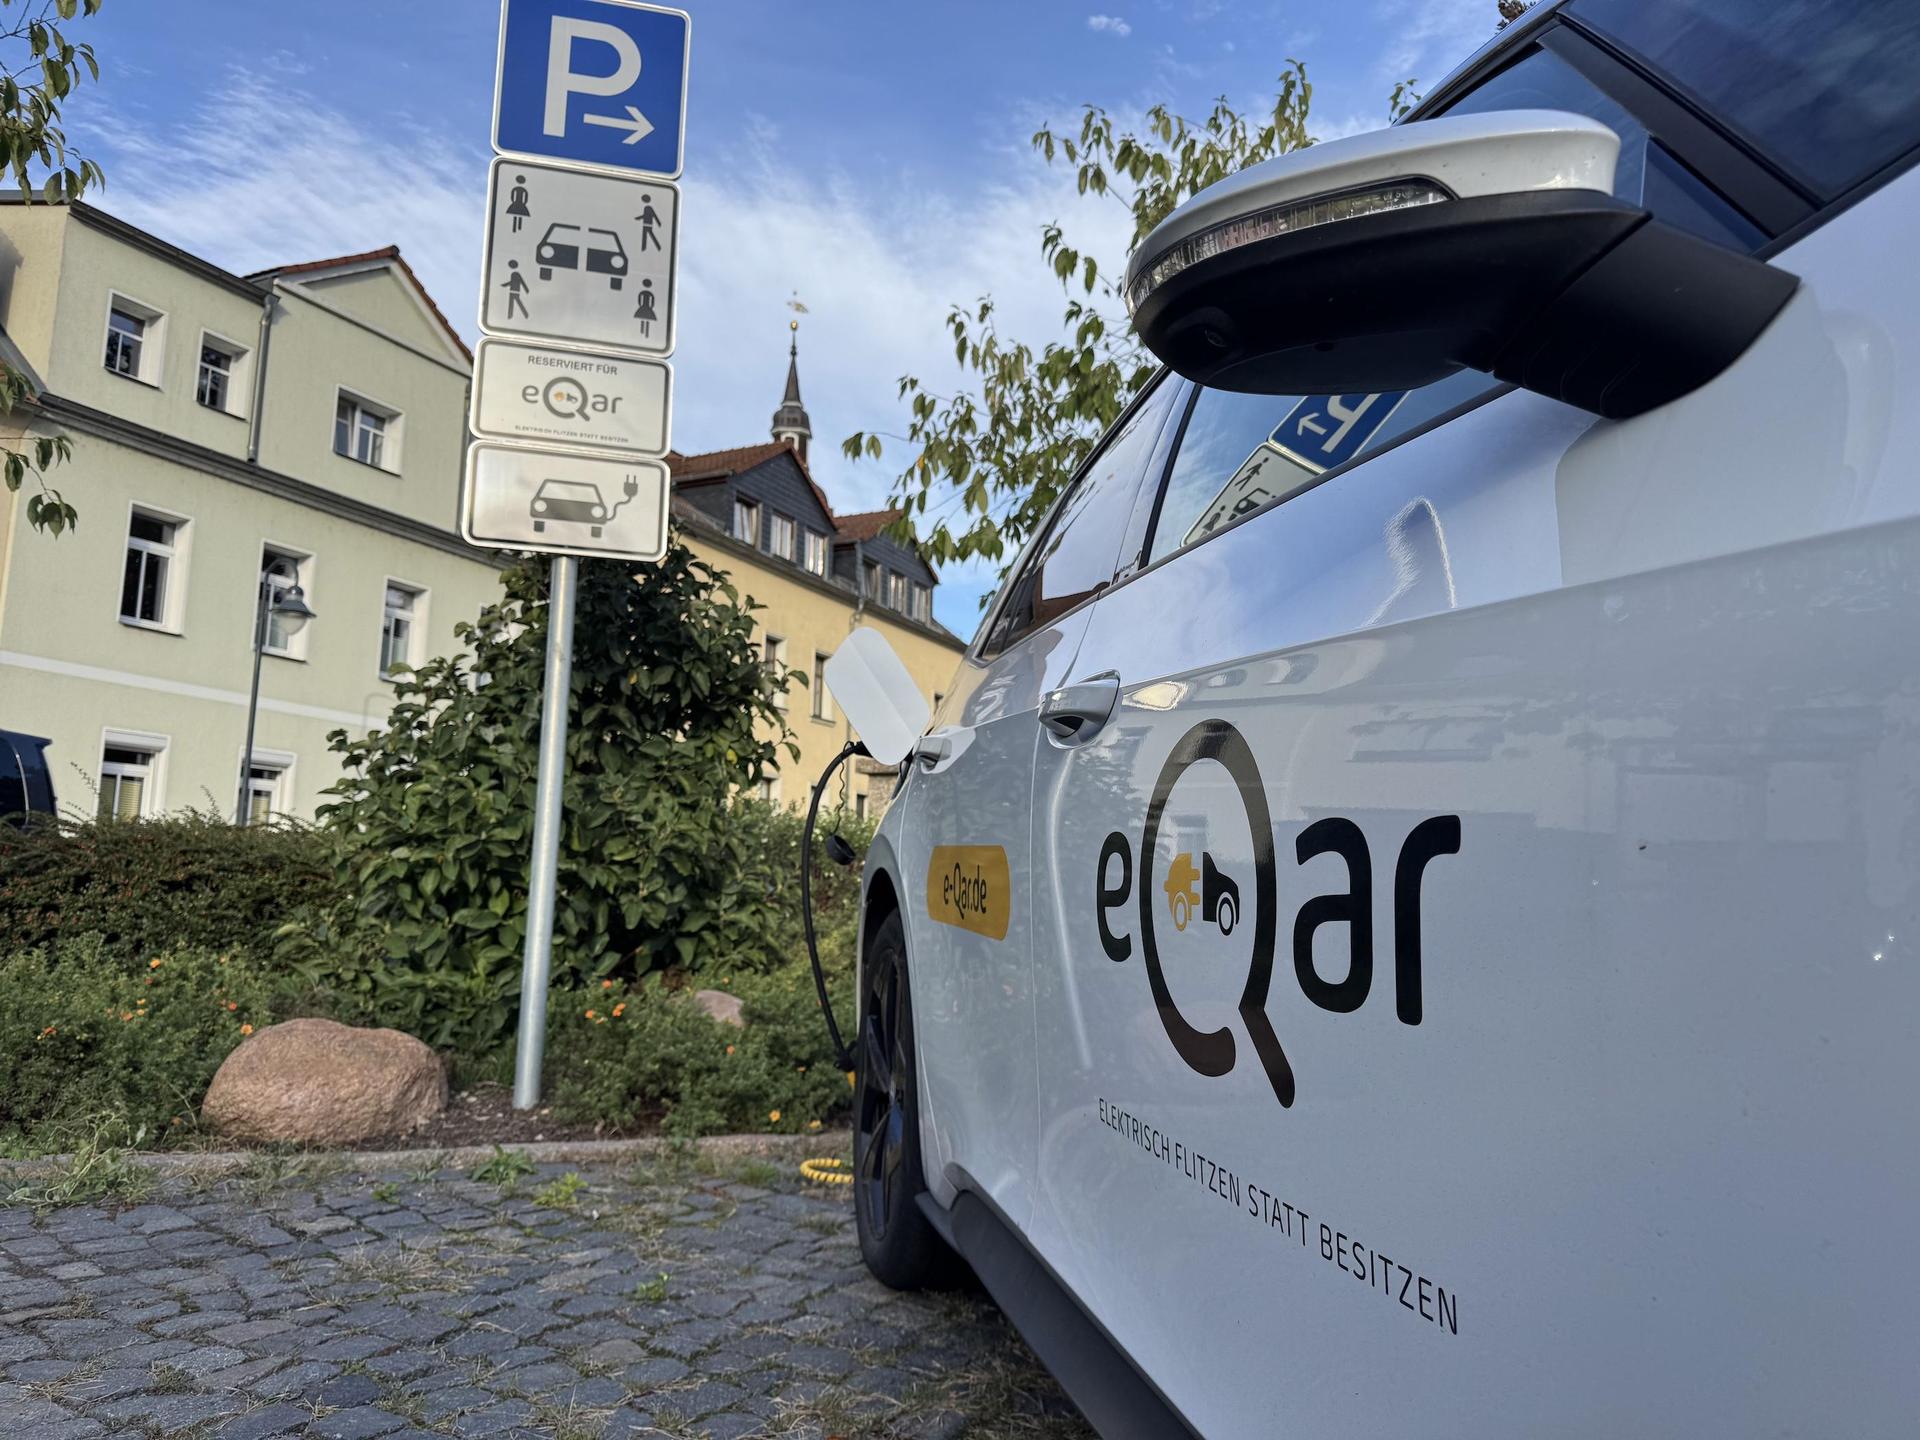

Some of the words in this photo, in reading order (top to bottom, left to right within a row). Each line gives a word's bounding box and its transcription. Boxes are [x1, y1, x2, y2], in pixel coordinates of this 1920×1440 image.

[543, 15, 642, 137] P
[521, 376, 623, 421] eQar
[528, 355, 594, 372] RESERVIERT
[596, 364, 618, 375] FÜR
[943, 862, 987, 920] e-Qar.de
[1097, 718, 1461, 1109] eQar
[1099, 1097, 1170, 1164] ELEKTRISCH
[1175, 1142, 1240, 1207] FLITZEN
[1248, 1184, 1309, 1247] STATT
[1319, 1223, 1457, 1335] BESITZEN
